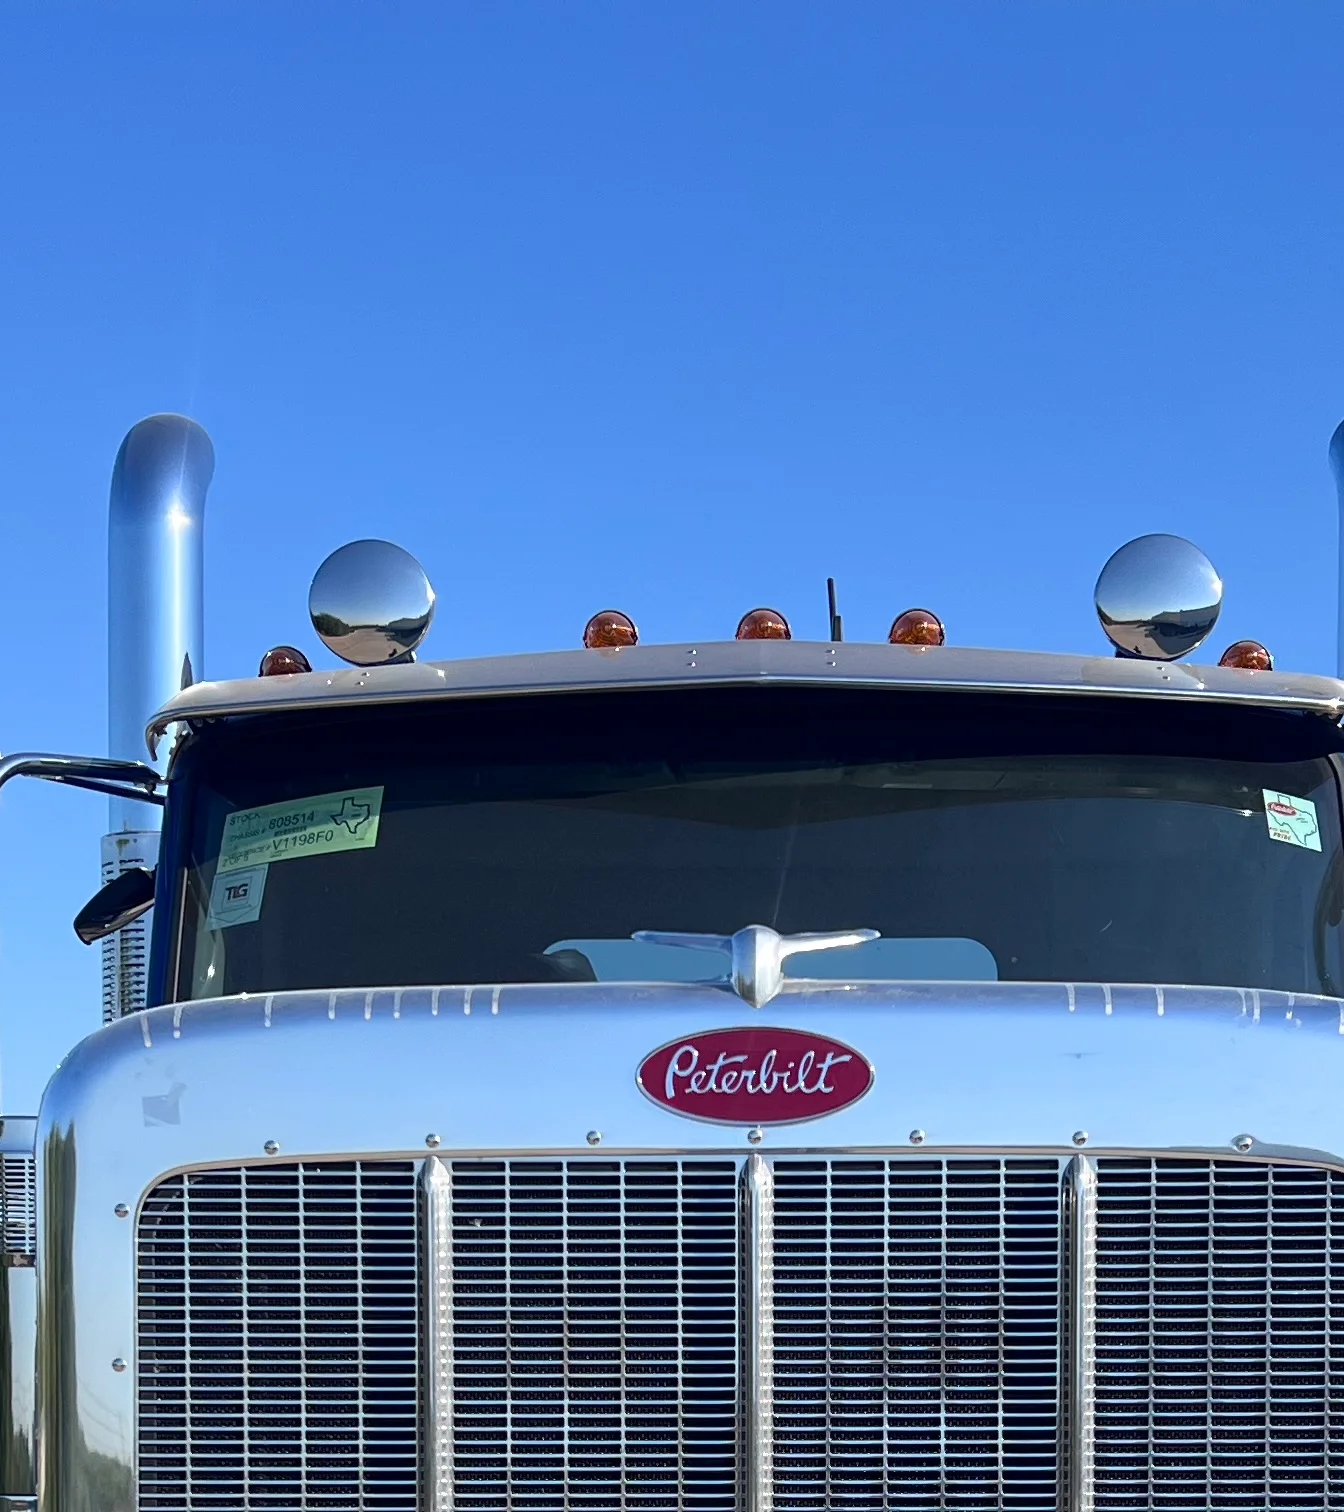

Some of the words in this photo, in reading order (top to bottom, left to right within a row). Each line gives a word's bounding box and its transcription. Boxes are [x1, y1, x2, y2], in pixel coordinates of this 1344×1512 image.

[230, 812, 260, 826] STOCK
[269, 810, 314, 830] 808514
[272, 829, 334, 851] V1198F0
[665, 1045, 853, 1099] Peterbilt
